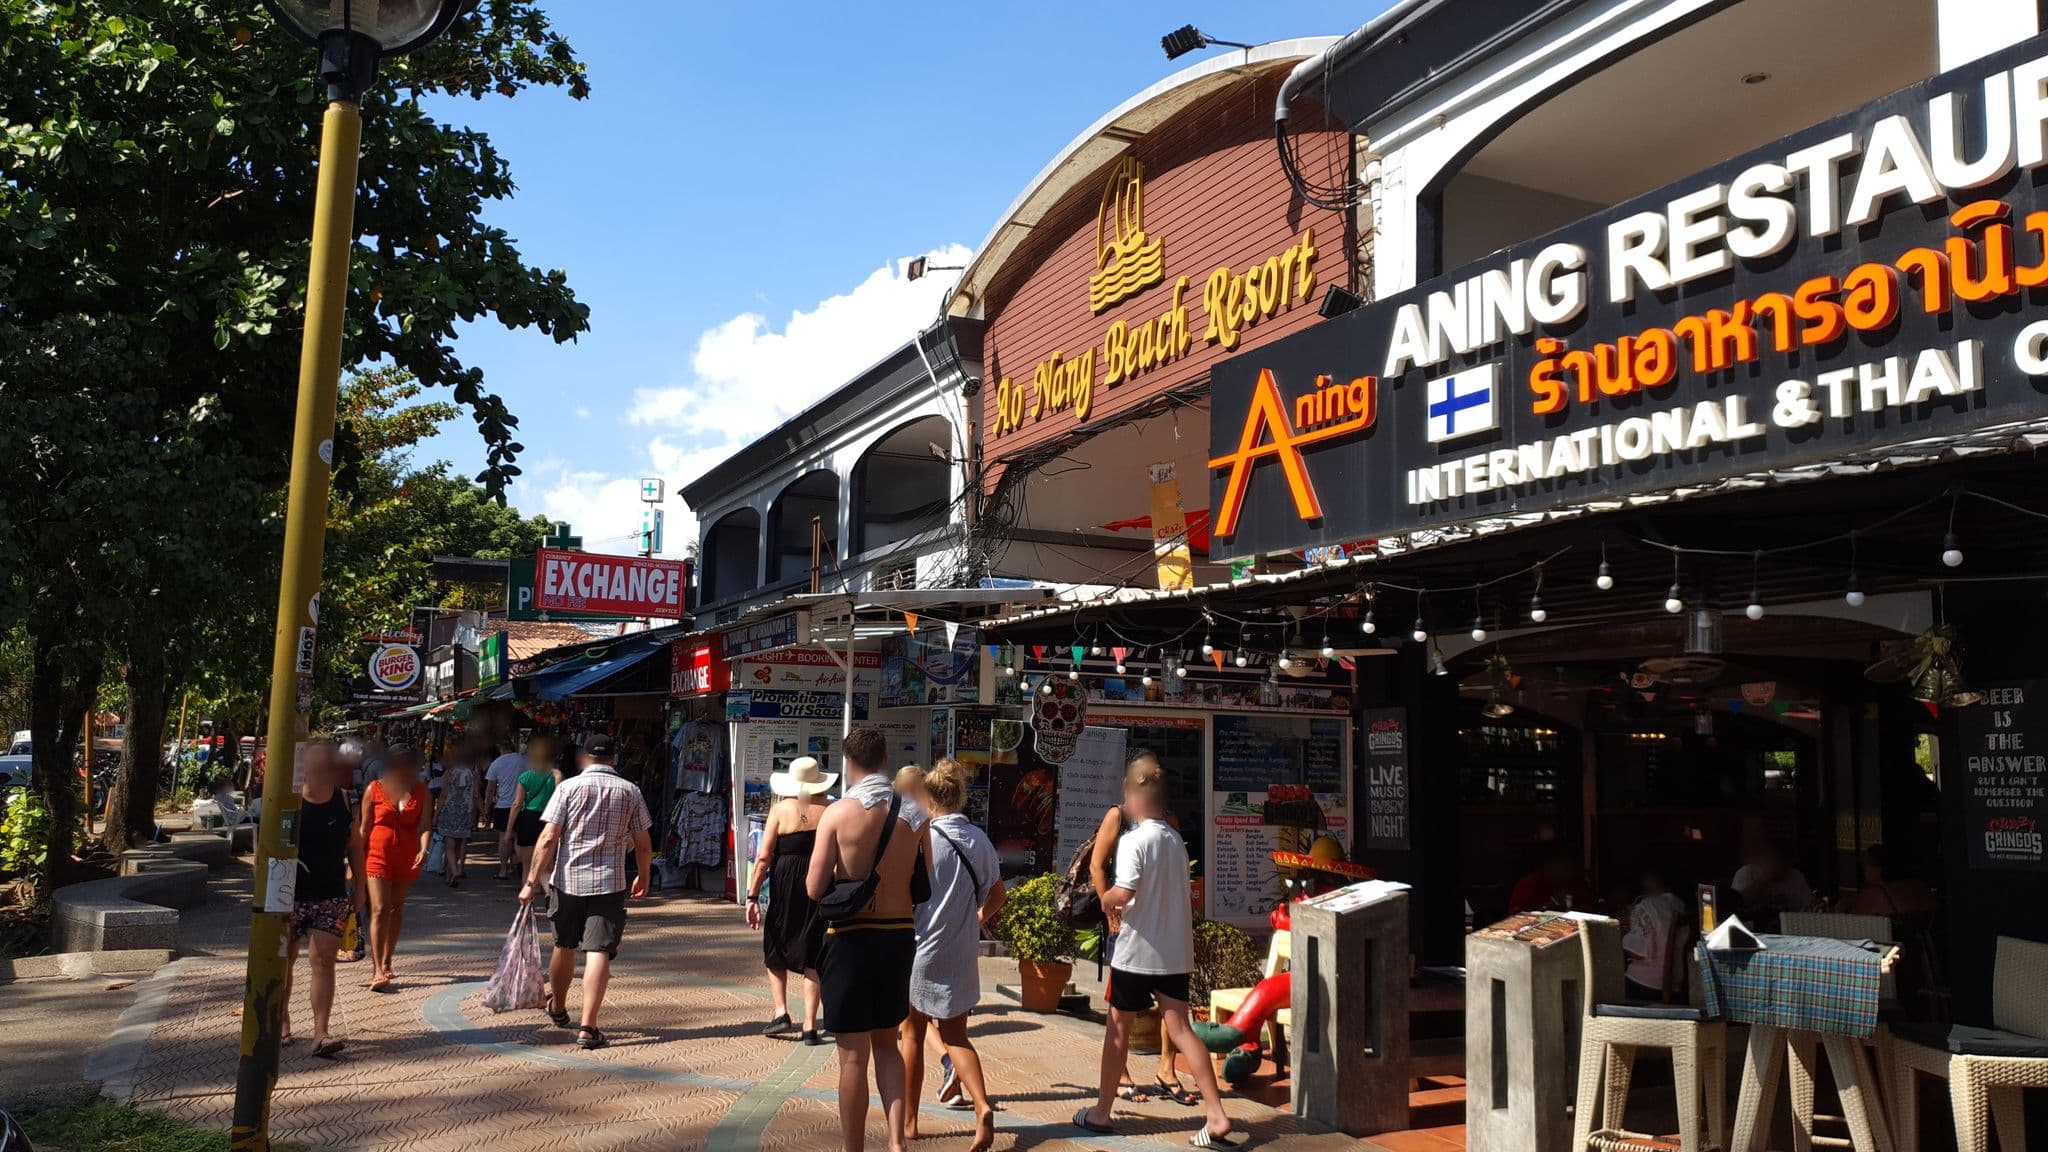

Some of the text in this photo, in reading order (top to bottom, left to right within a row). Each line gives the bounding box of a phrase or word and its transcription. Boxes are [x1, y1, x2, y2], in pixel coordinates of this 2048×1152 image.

[1383, 243, 1588, 379] ANING
[992, 227, 1319, 434] Ao Nang Beach Resort
[1407, 395, 1767, 505] INTERNATIONAL
[1772, 379, 1822, 429] &
[1817, 338, 1985, 419] THAI
[1208, 366, 1378, 537] Aning
[544, 558, 680, 605] EXCHANGE
[518, 586, 534, 611] P
[654, 607, 679, 615] SERVICE
[378, 653, 414, 667] BURGER
[797, 653, 840, 664] BOOKIN
[842, 653, 878, 666] CNTER
[379, 661, 415, 678] KING
[670, 663, 711, 694] EXCHANGE
[752, 690, 826, 704] Promotion
[1979, 687, 2025, 706] BEER
[1993, 710, 2012, 728] IS
[1984, 732, 2025, 751] THE
[1967, 755, 2047, 773] ANSWER
[1369, 764, 1403, 785] LIVE
[1369, 785, 1407, 798] MUSIC
[2027, 787, 2046, 797] THE
[1986, 798, 2035, 808] QUESTION
[1370, 815, 1406, 838] NIGHT
